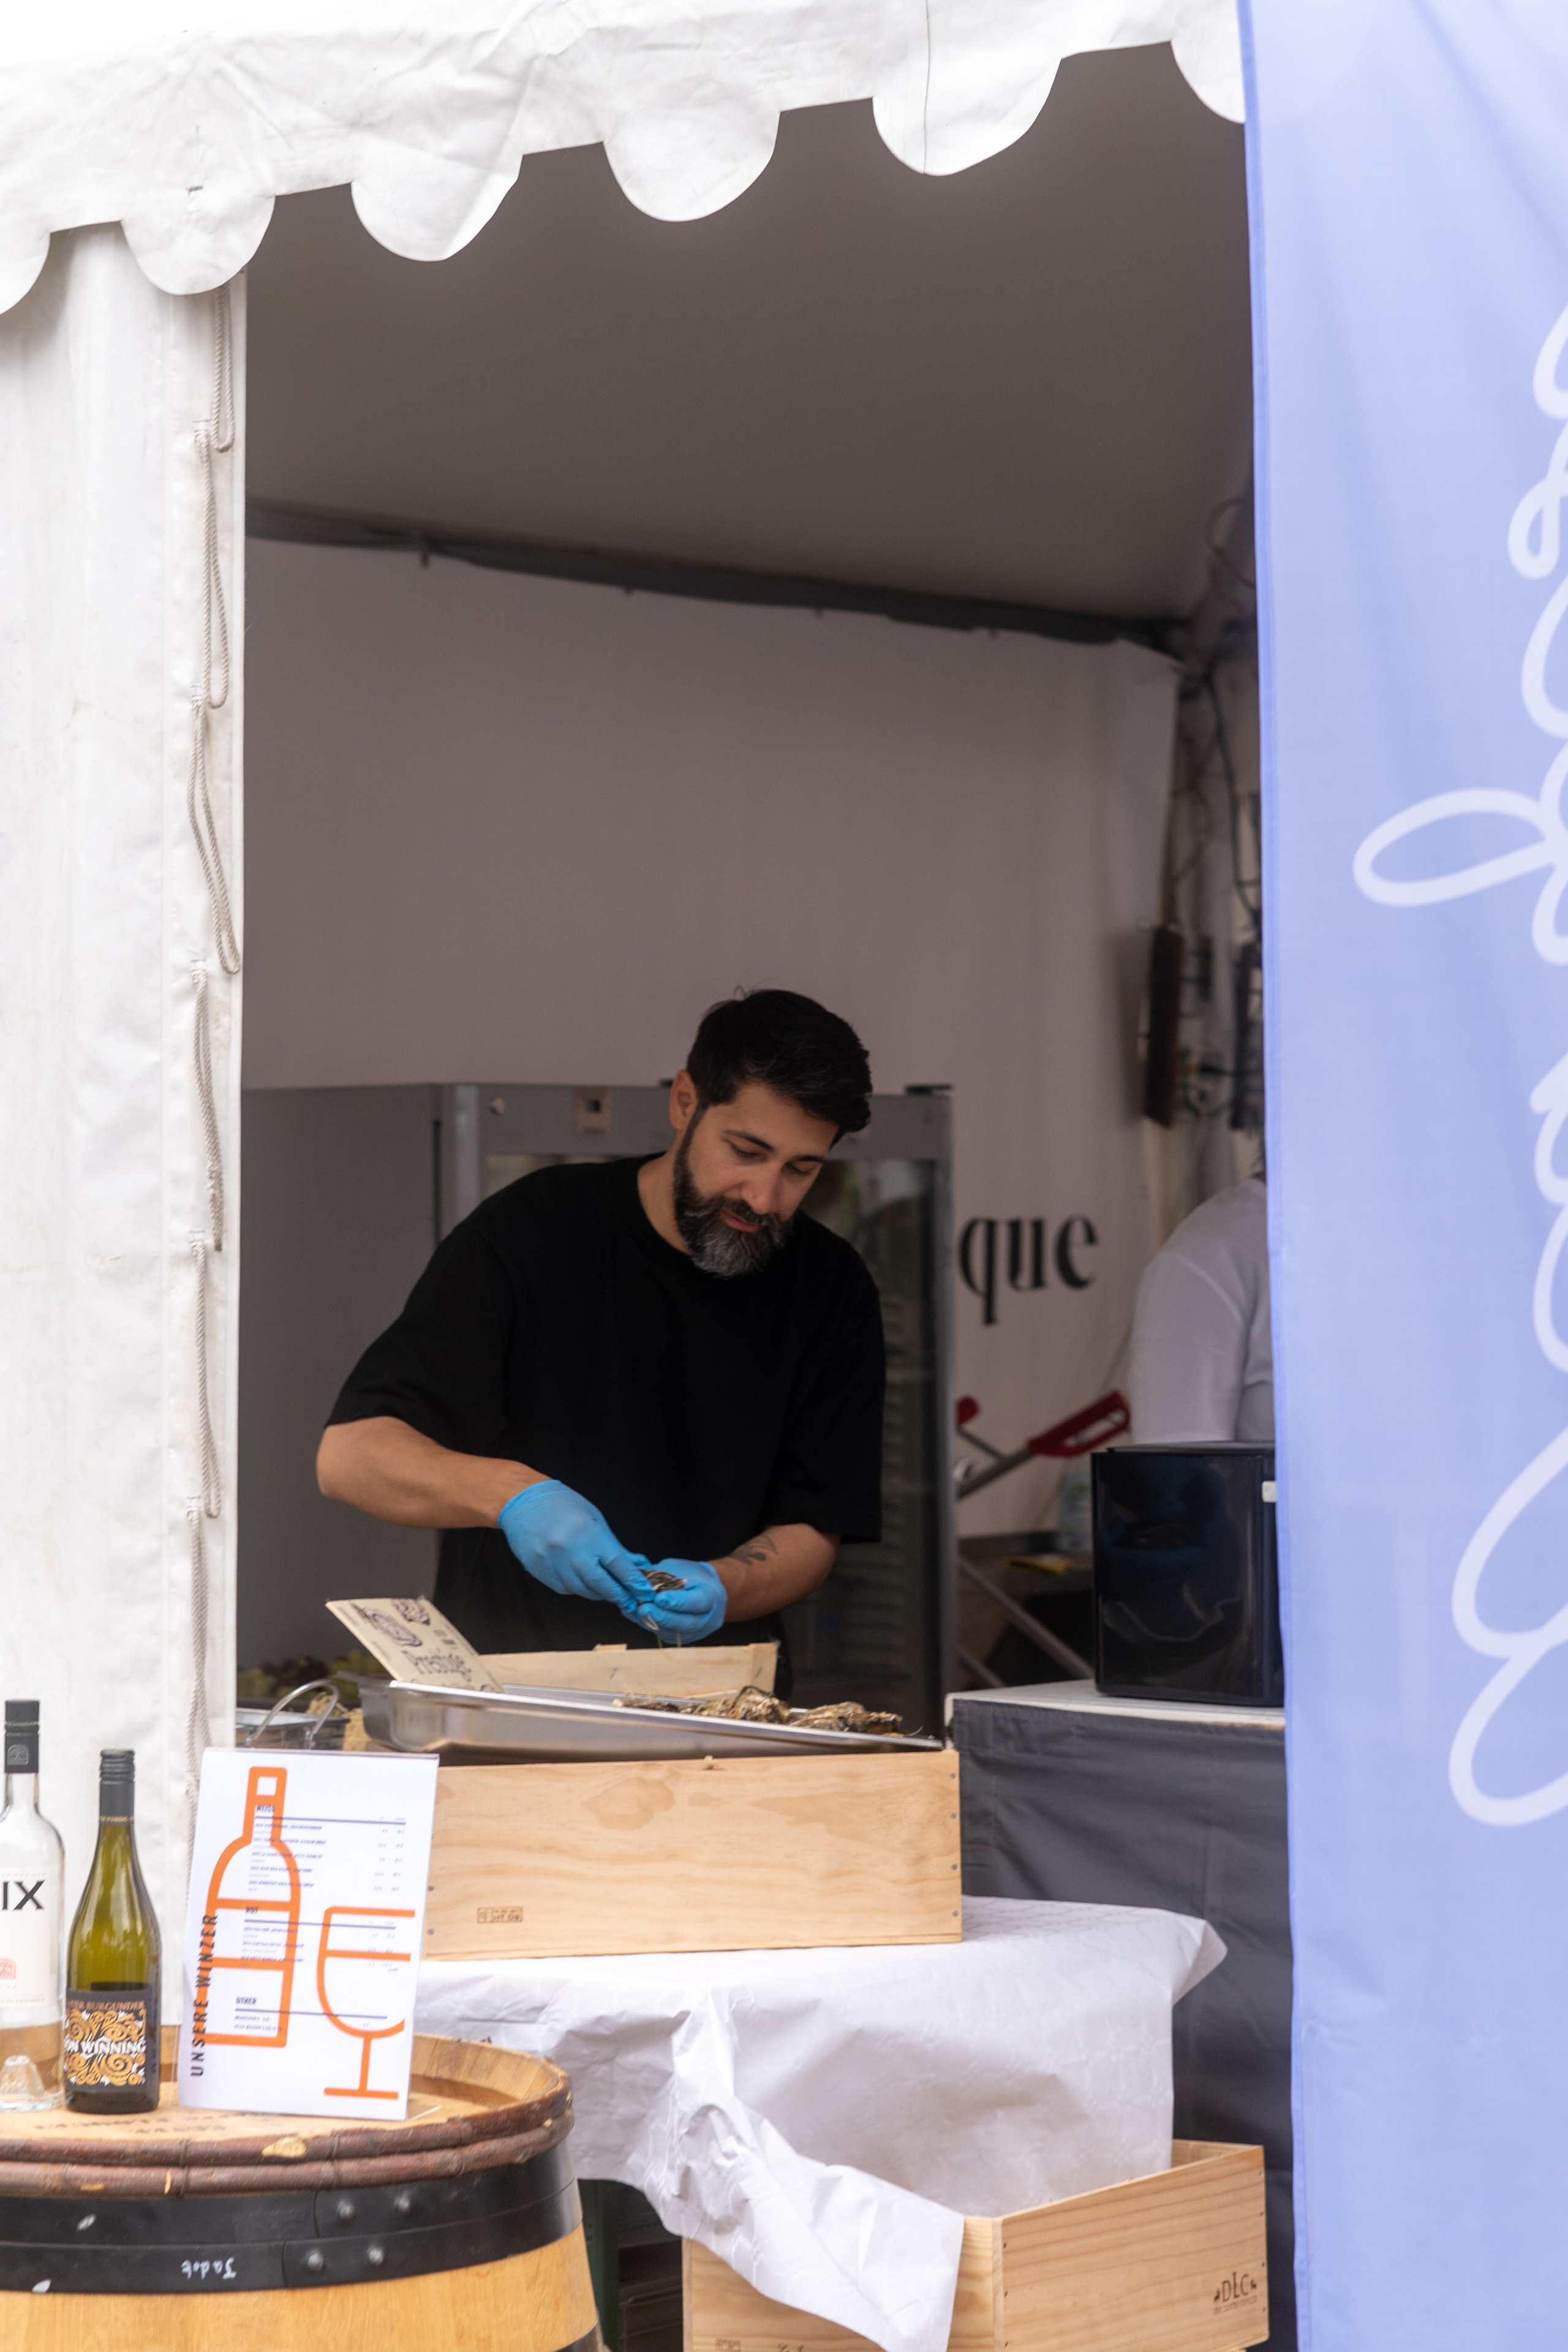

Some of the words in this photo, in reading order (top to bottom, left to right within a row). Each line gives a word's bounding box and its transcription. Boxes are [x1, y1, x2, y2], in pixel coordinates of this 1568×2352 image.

[958, 1214, 1098, 1326] que
[195, 1914, 218, 1989] WINZER
[80, 2036, 147, 2056] WINNING
[190, 1999, 209, 2077] UNSERE
[1221, 2271, 1250, 2302] DLC
